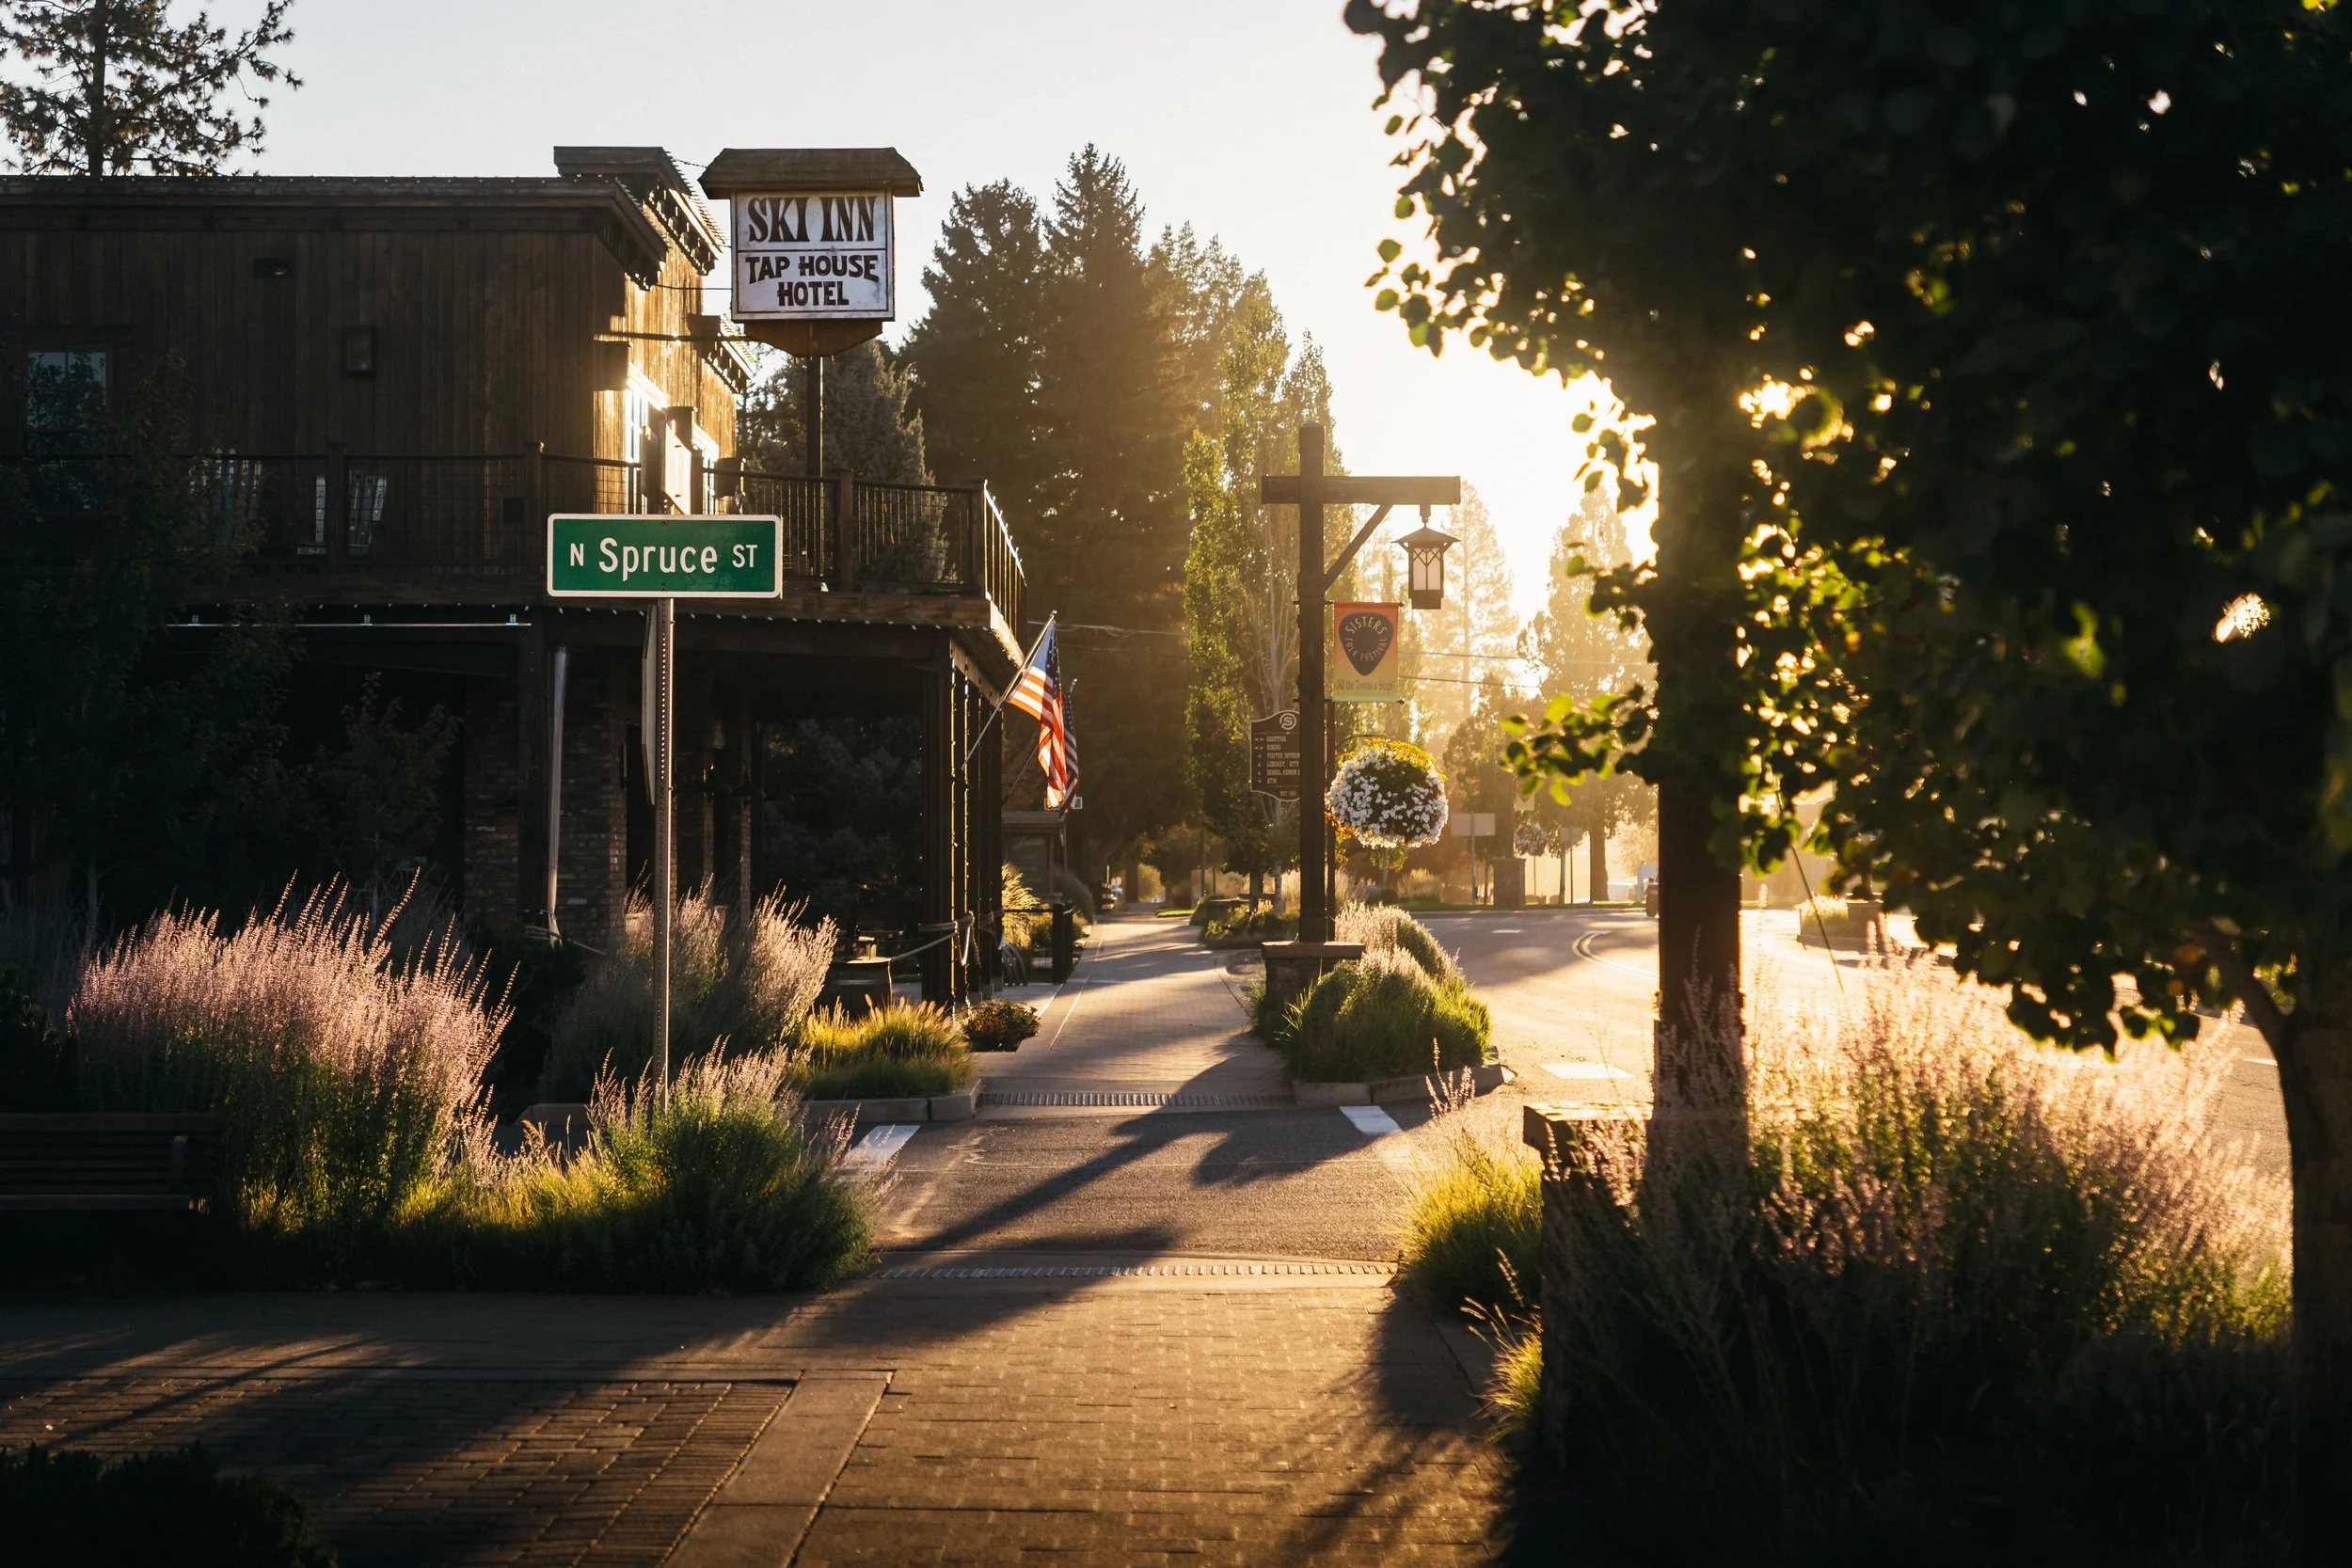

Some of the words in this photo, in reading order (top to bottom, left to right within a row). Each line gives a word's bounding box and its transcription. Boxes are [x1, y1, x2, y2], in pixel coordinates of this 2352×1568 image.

[747, 197, 810, 243] SKI
[819, 196, 877, 243] INN
[745, 256, 790, 285] TAP
[798, 255, 881, 283] HOUSE
[777, 281, 850, 307] HOTEL
[570, 543, 584, 567] N
[598, 537, 718, 582] Spruce
[732, 544, 758, 568] ST
[1345, 616, 1388, 635] SISTERS
[1345, 638, 1358, 657] FOLK
[1359, 638, 1387, 661] FESTIVAL
